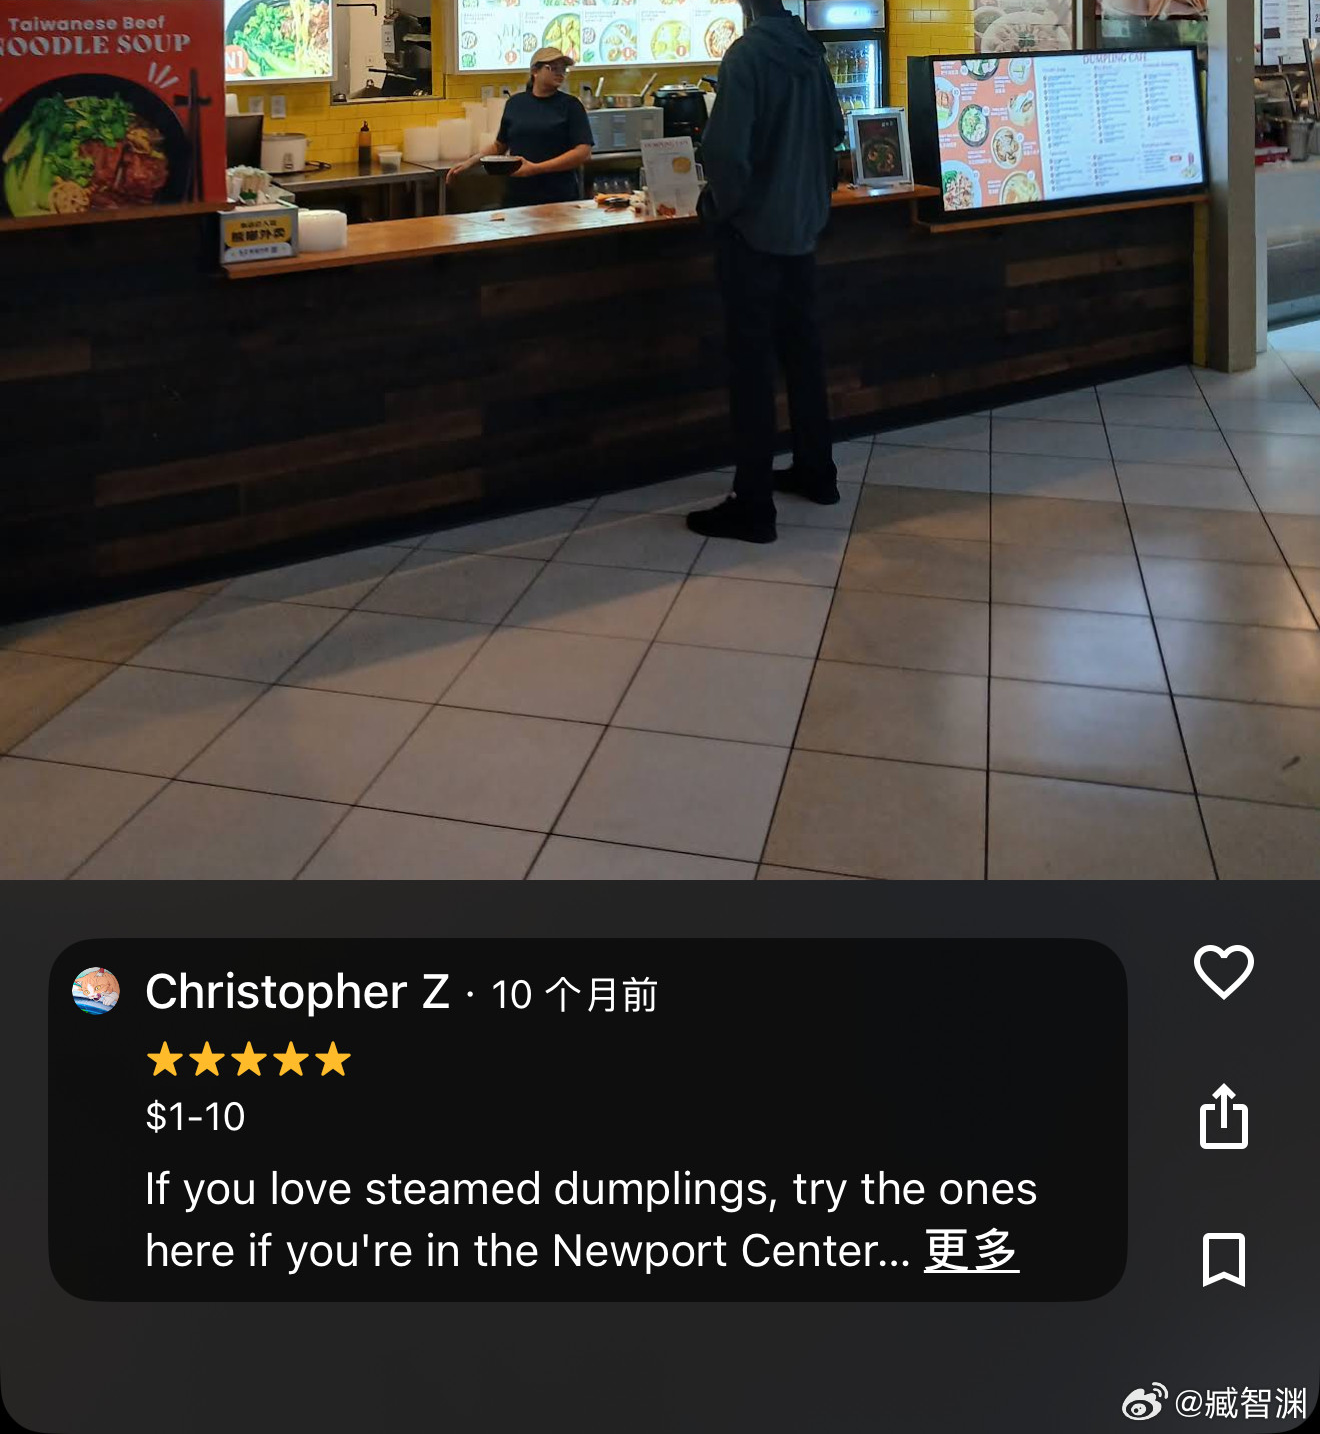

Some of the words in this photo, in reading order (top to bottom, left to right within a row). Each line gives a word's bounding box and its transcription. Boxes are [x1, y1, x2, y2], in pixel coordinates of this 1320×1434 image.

[7, 16, 118, 32] Taiwanese
[122, 15, 165, 31] Beef
[117, 33, 191, 55] SOUP
